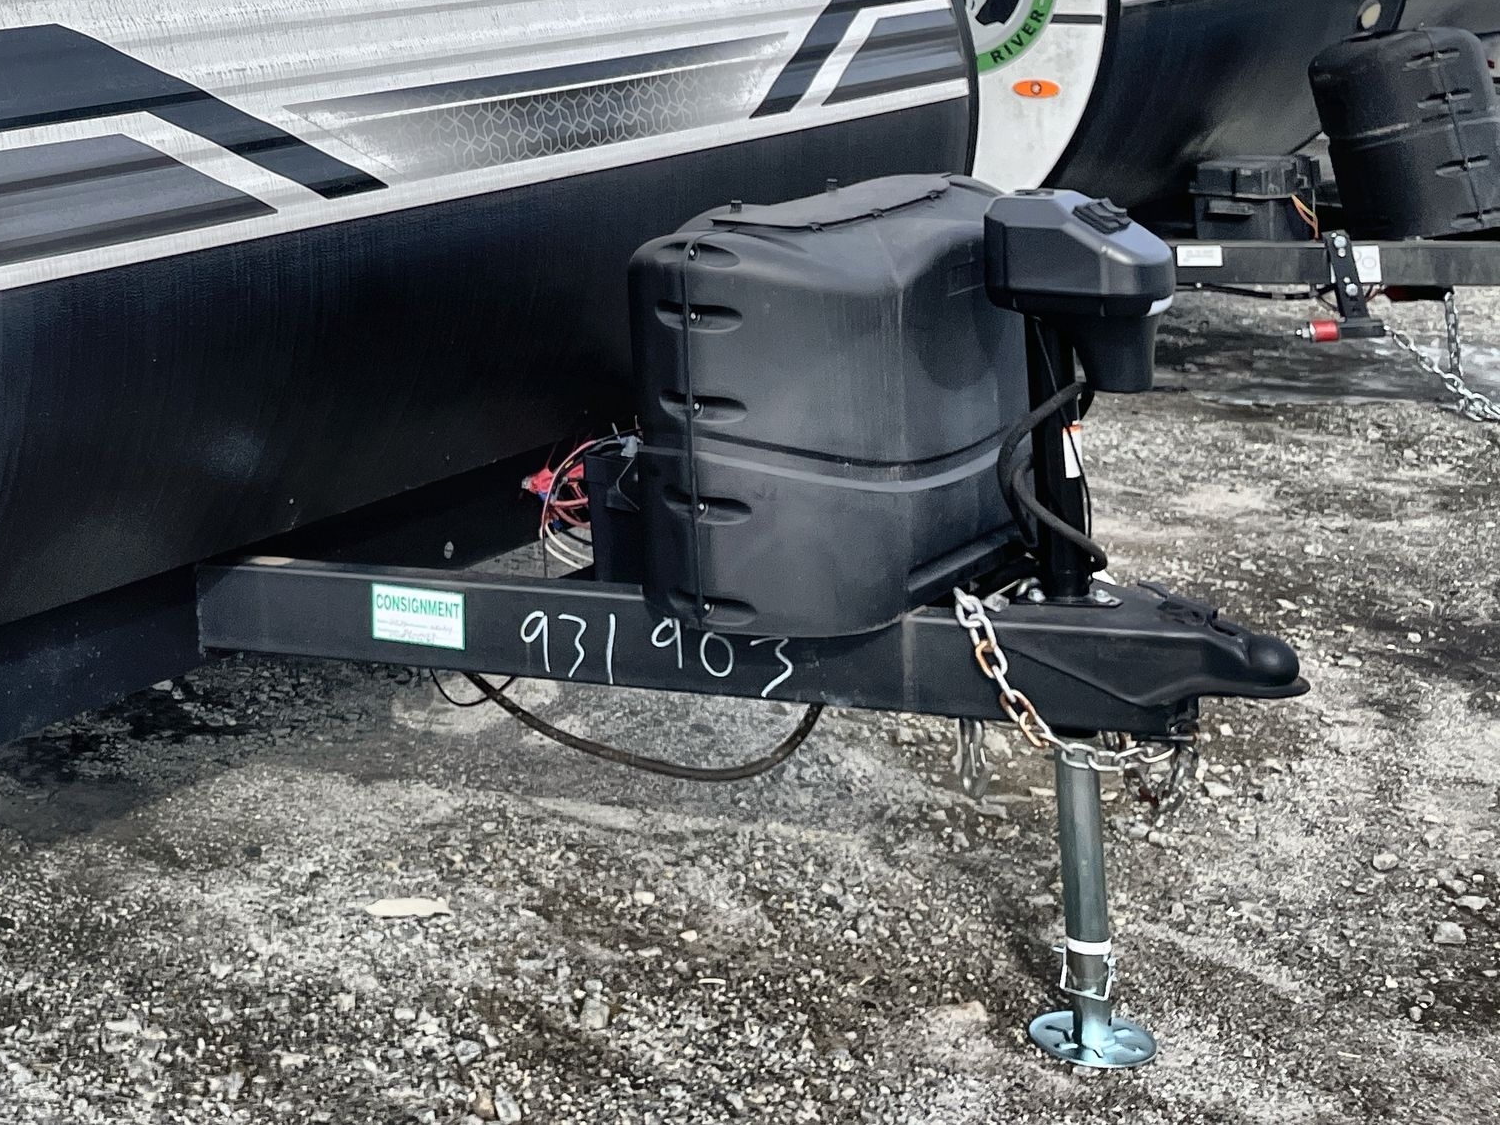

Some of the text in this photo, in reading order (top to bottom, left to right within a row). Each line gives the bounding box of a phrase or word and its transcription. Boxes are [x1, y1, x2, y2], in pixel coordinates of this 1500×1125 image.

[990, 9, 1046, 64] RIVER
[376, 593, 460, 620] CONSIGNMENT
[519, 610, 794, 698] 931 903
